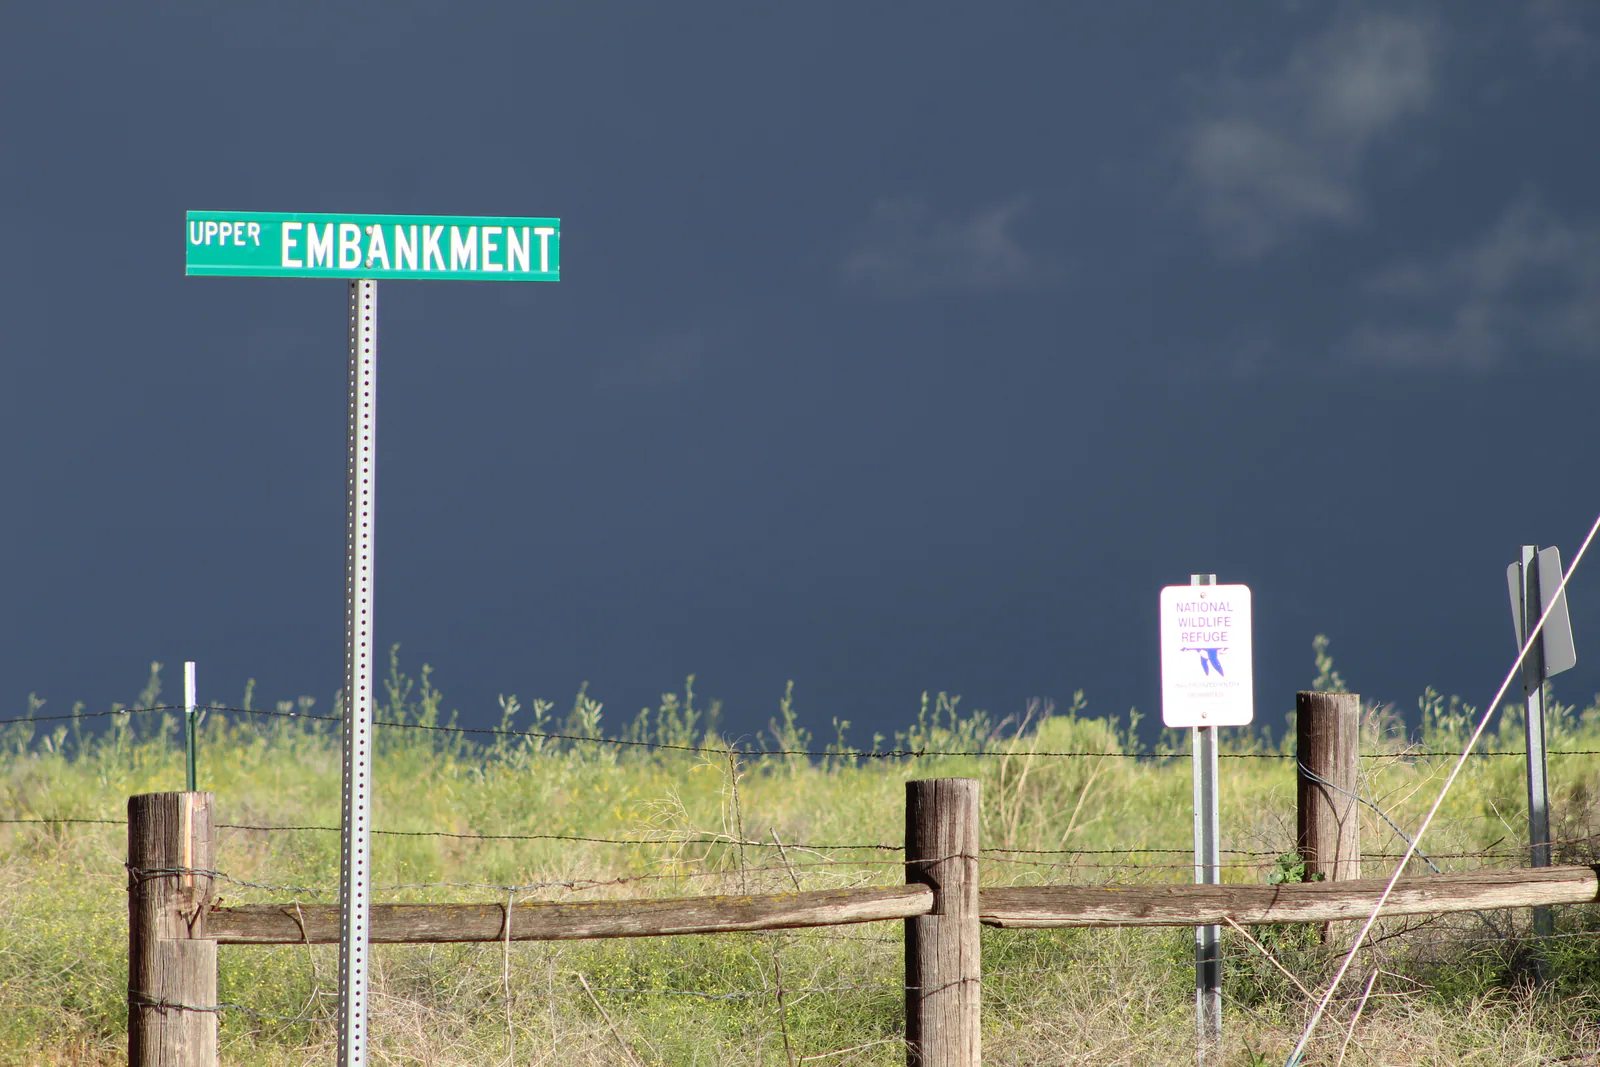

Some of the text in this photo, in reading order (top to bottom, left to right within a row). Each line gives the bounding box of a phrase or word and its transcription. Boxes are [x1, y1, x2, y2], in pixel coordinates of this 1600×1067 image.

[189, 221, 555, 273] UPPER EMBANKMENT
[1176, 602, 1233, 612] NATIONAL
[1178, 617, 1231, 627] WILDLIFE
[1181, 632, 1228, 642] REFUGE
